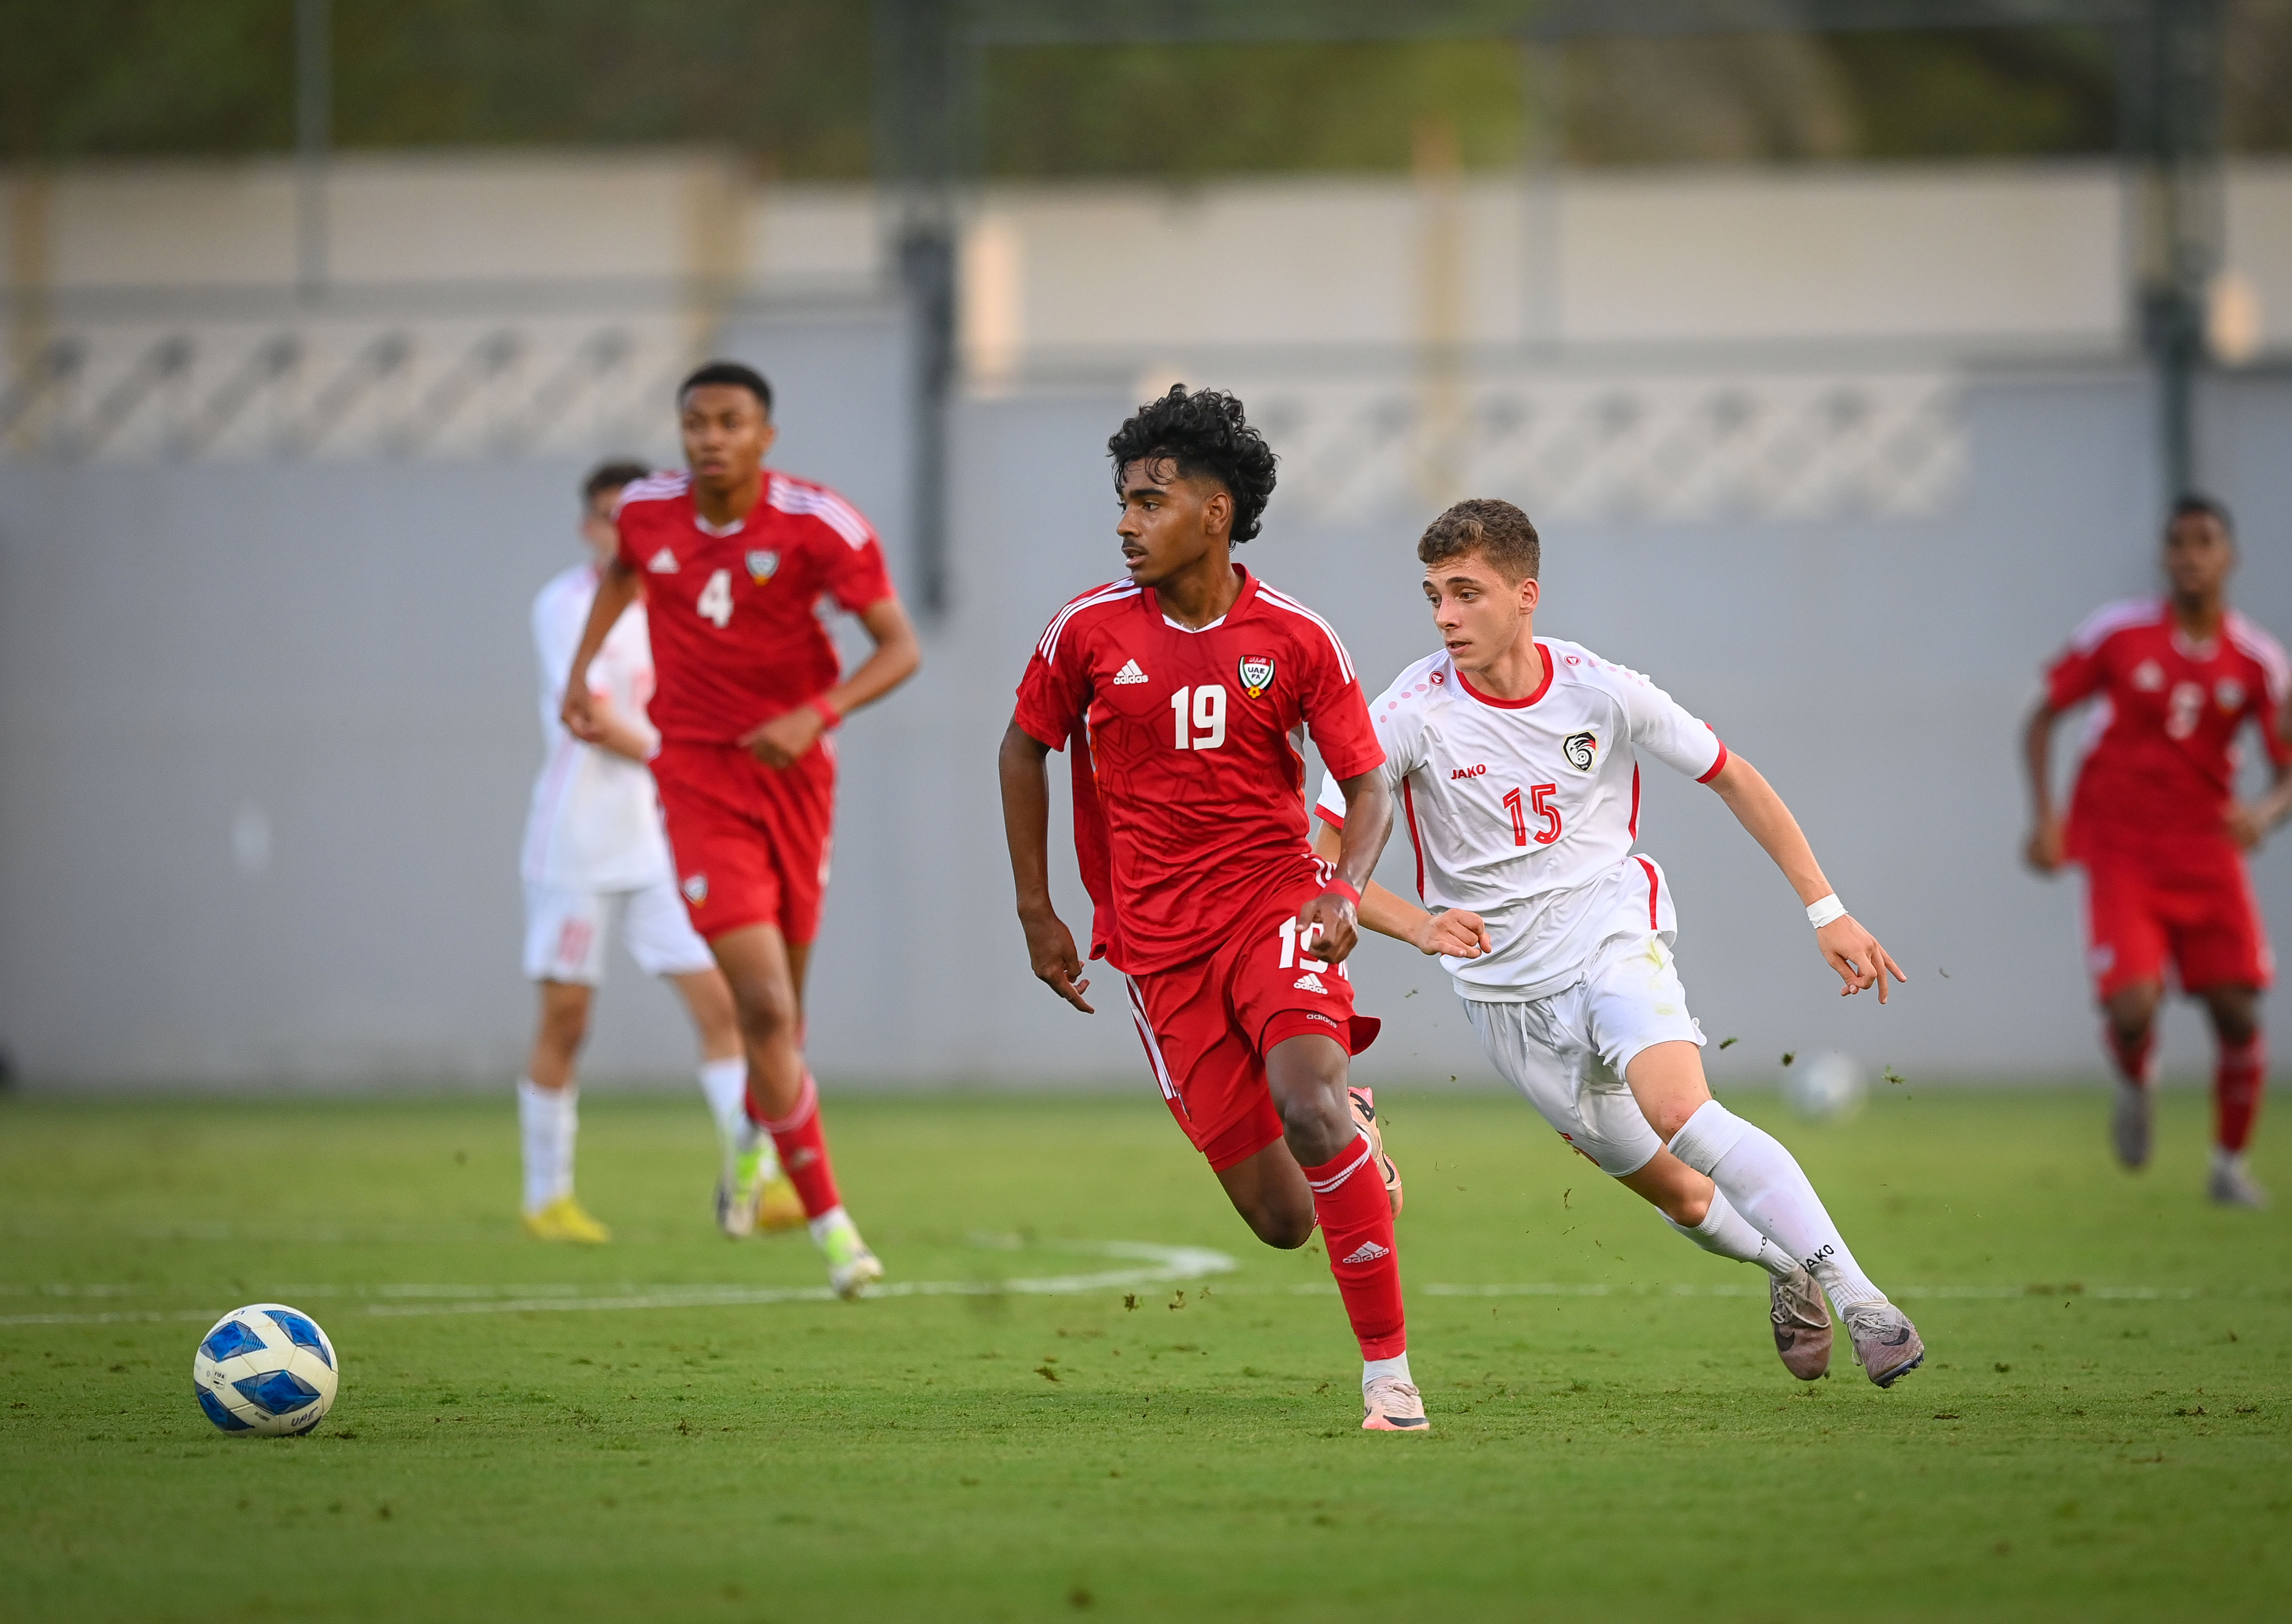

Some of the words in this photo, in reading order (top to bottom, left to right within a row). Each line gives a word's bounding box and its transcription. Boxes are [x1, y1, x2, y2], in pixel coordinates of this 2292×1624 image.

[697, 568, 734, 627] 4
[1113, 675, 1149, 685] adidas
[1171, 684, 1227, 751] 19
[1451, 764, 1486, 780] JAKO
[1502, 783, 1561, 846] 15
[1293, 982, 1328, 994] adidas
[1306, 1013, 1337, 1028] adidas
[1342, 1247, 1390, 1263] adidas
[1800, 1244, 1834, 1272] JAKO
